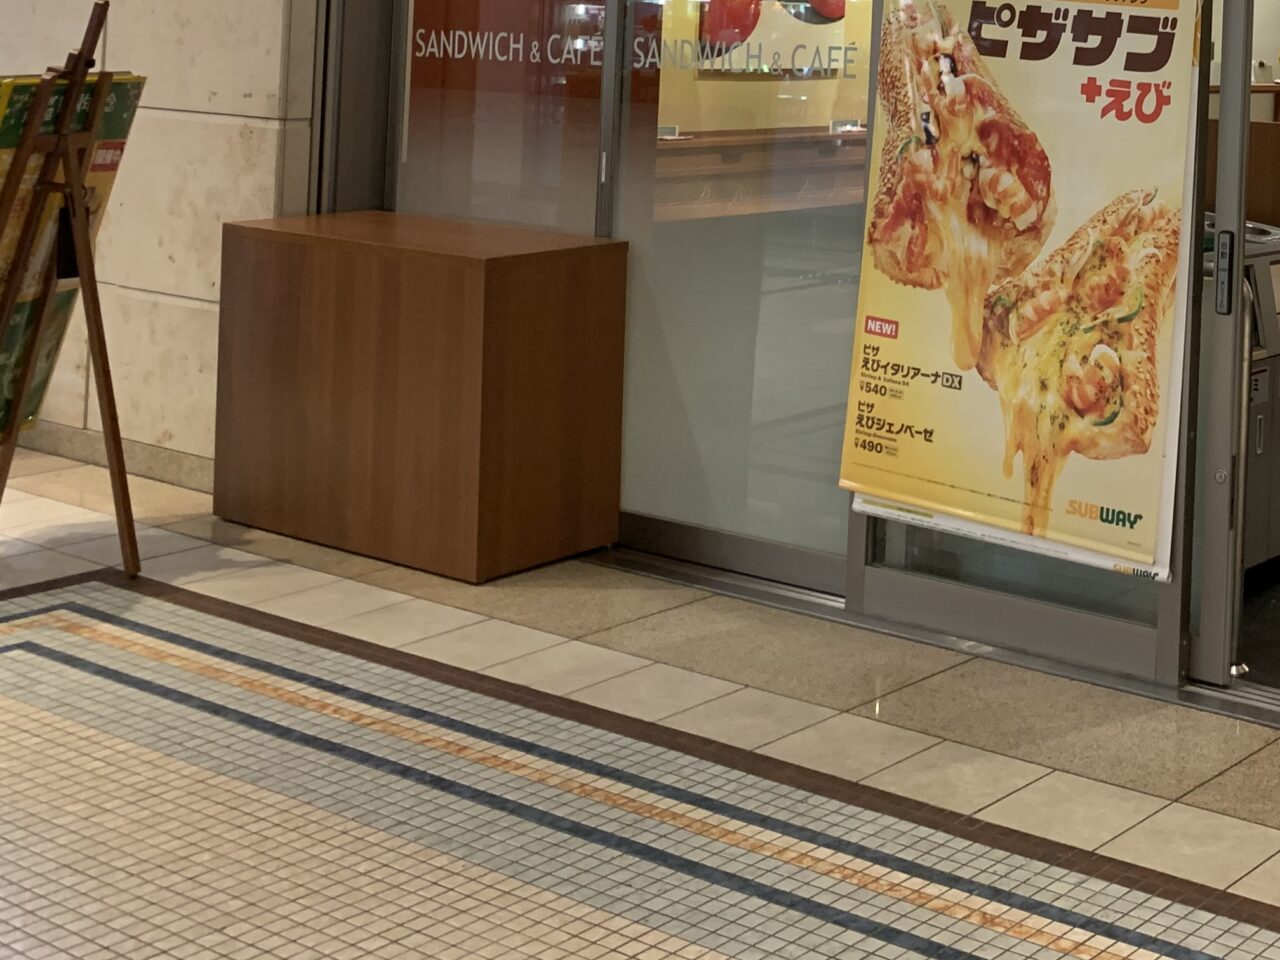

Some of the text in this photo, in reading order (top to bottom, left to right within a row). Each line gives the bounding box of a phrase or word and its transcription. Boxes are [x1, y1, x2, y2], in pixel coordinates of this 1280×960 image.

[415, 29, 604, 66] SANDWICH & CAFÉ
[968, 0, 1178, 72] ピザサブ
[633, 37, 858, 79] SANDWICH & CAFÉ
[1081, 77, 1172, 123] +えび
[867, 319, 896, 336] NEW!
[863, 343, 880, 357] ピザ
[857, 400, 875, 414] ピザ
[1065, 499, 1144, 530] SUBWAY
[1112, 563, 1159, 581] SUBWAY
